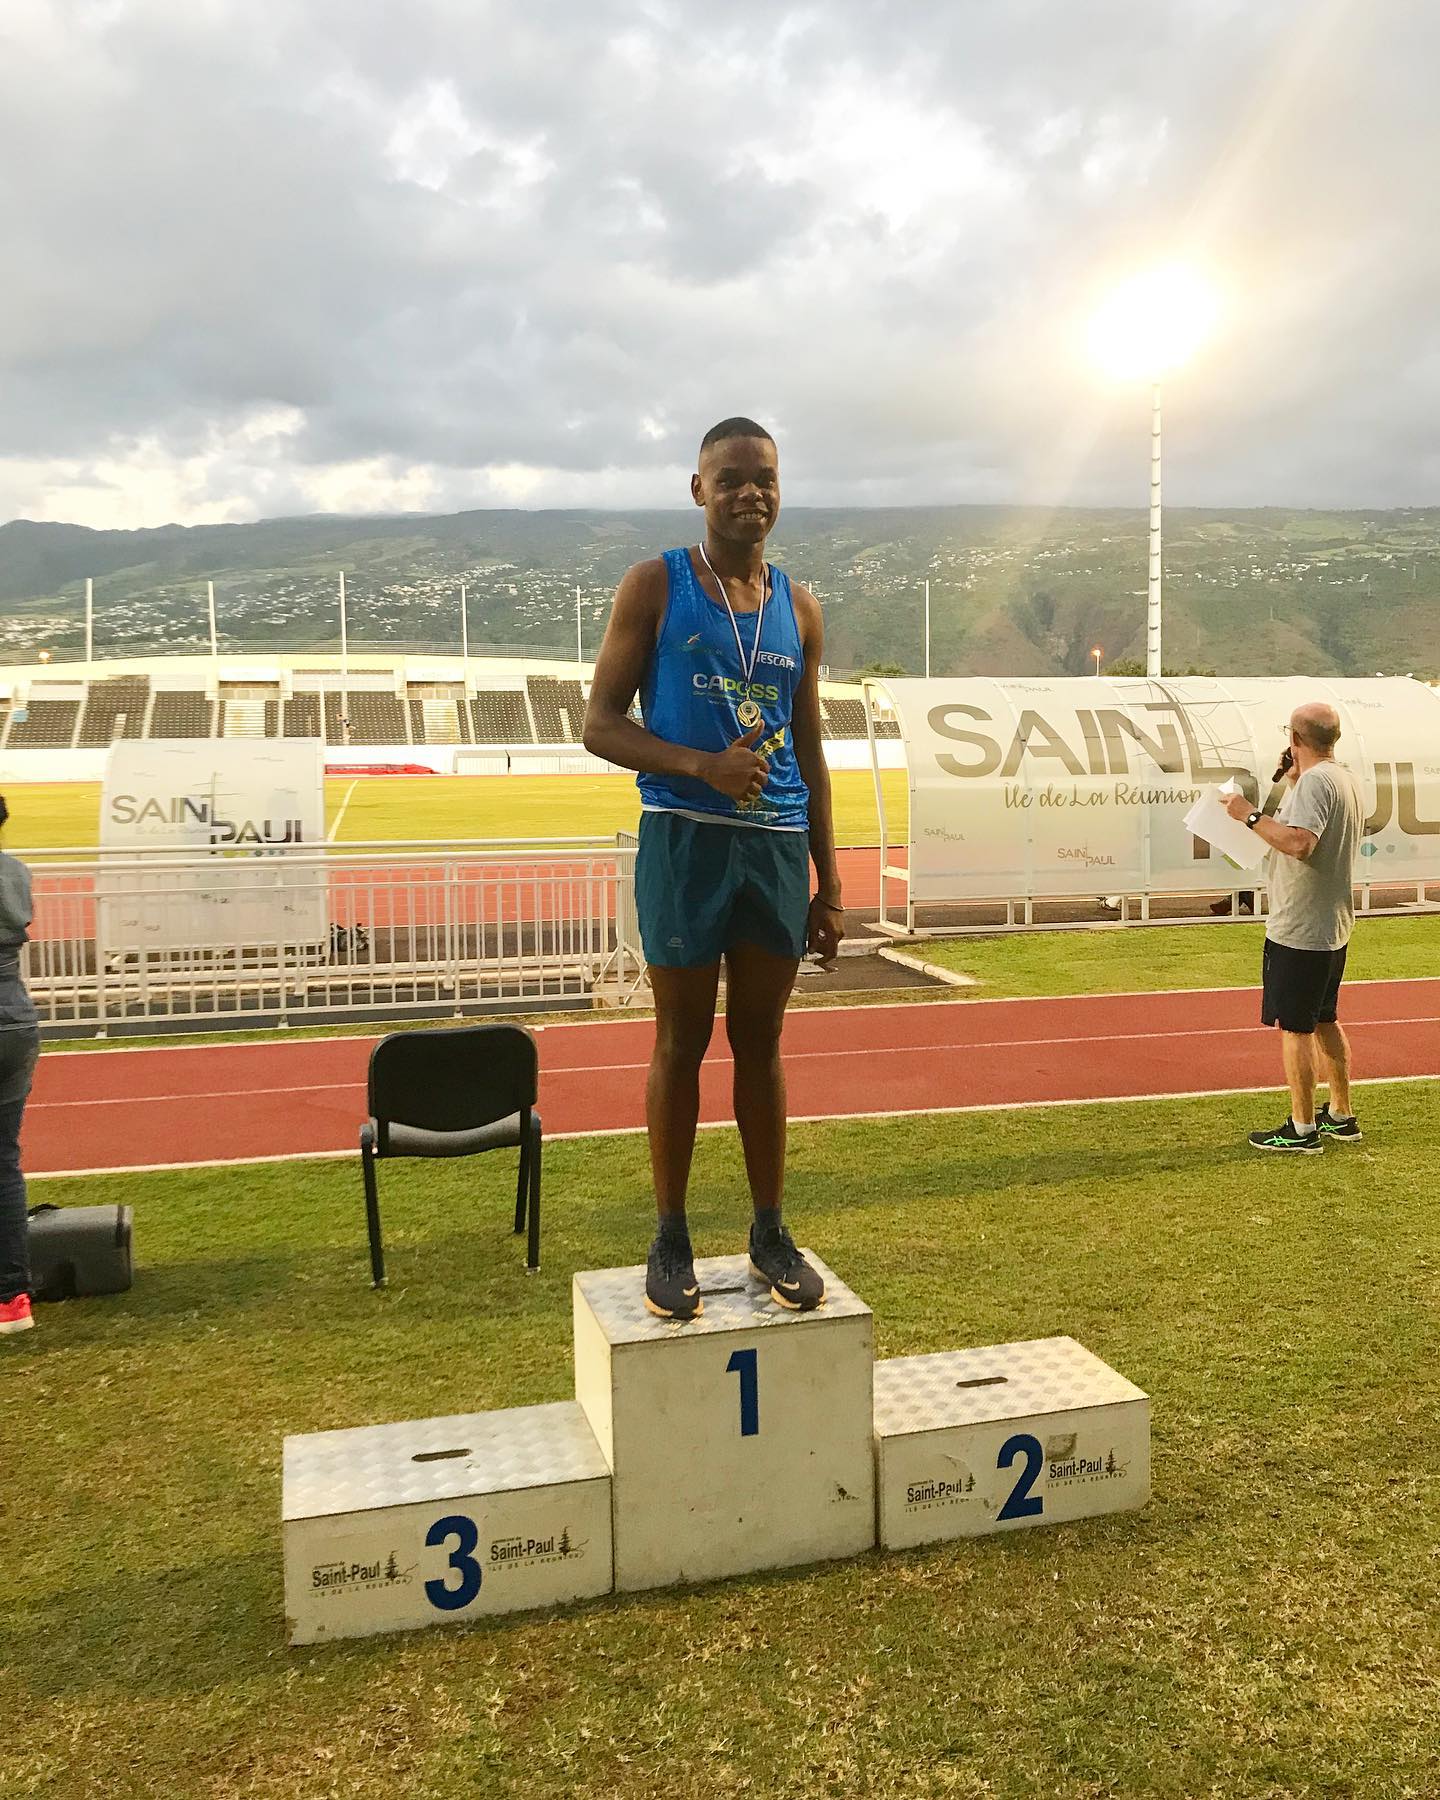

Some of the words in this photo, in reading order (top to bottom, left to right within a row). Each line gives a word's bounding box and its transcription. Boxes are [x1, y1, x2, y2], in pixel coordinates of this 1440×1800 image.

[692, 673, 779, 701] CAPOSS
[1039, 783, 1066, 807] de
[1069, 783, 1108, 807] La
[1115, 782, 1202, 807] Réunion
[1190, 762, 1440, 860] PUL
[1085, 855, 1116, 868] PAUL
[726, 1348, 759, 1436] 1
[996, 1434, 1044, 1521] 2
[1049, 1456, 1103, 1479] Saint-Paul
[907, 1478, 963, 1503] Saint-Paul
[490, 1536, 554, 1561] Saint-Paul
[311, 1560, 381, 1588] Saint-Paul
[424, 1515, 482, 1611] 3
